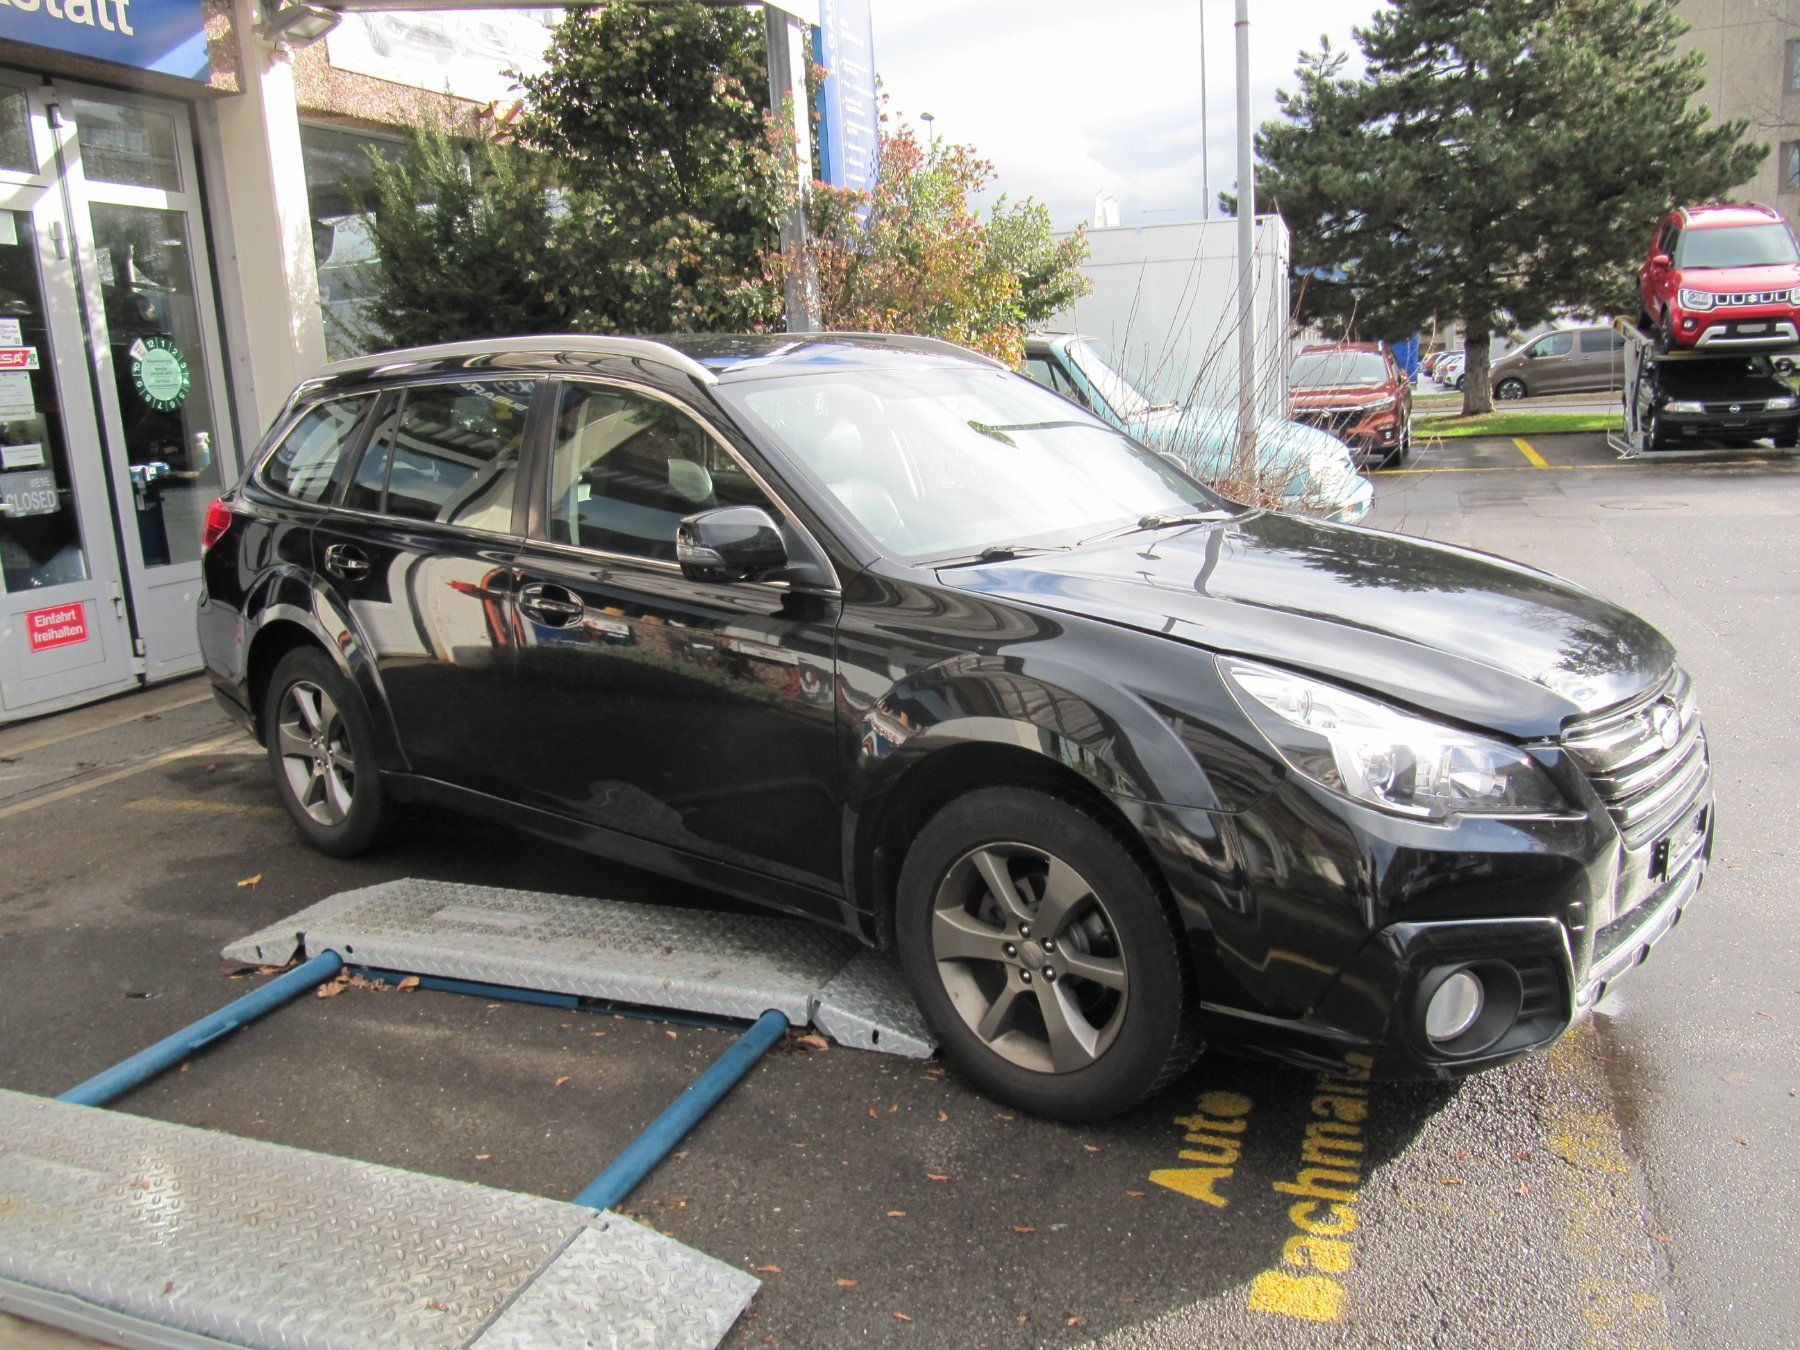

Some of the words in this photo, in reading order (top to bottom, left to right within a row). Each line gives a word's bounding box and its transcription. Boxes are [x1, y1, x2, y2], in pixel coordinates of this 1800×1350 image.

[5, 490, 56, 513] CLOSED
[34, 609, 77, 628] Einfahrt
[34, 625, 83, 643] freihalten
[1149, 1090, 1253, 1208] Auto
